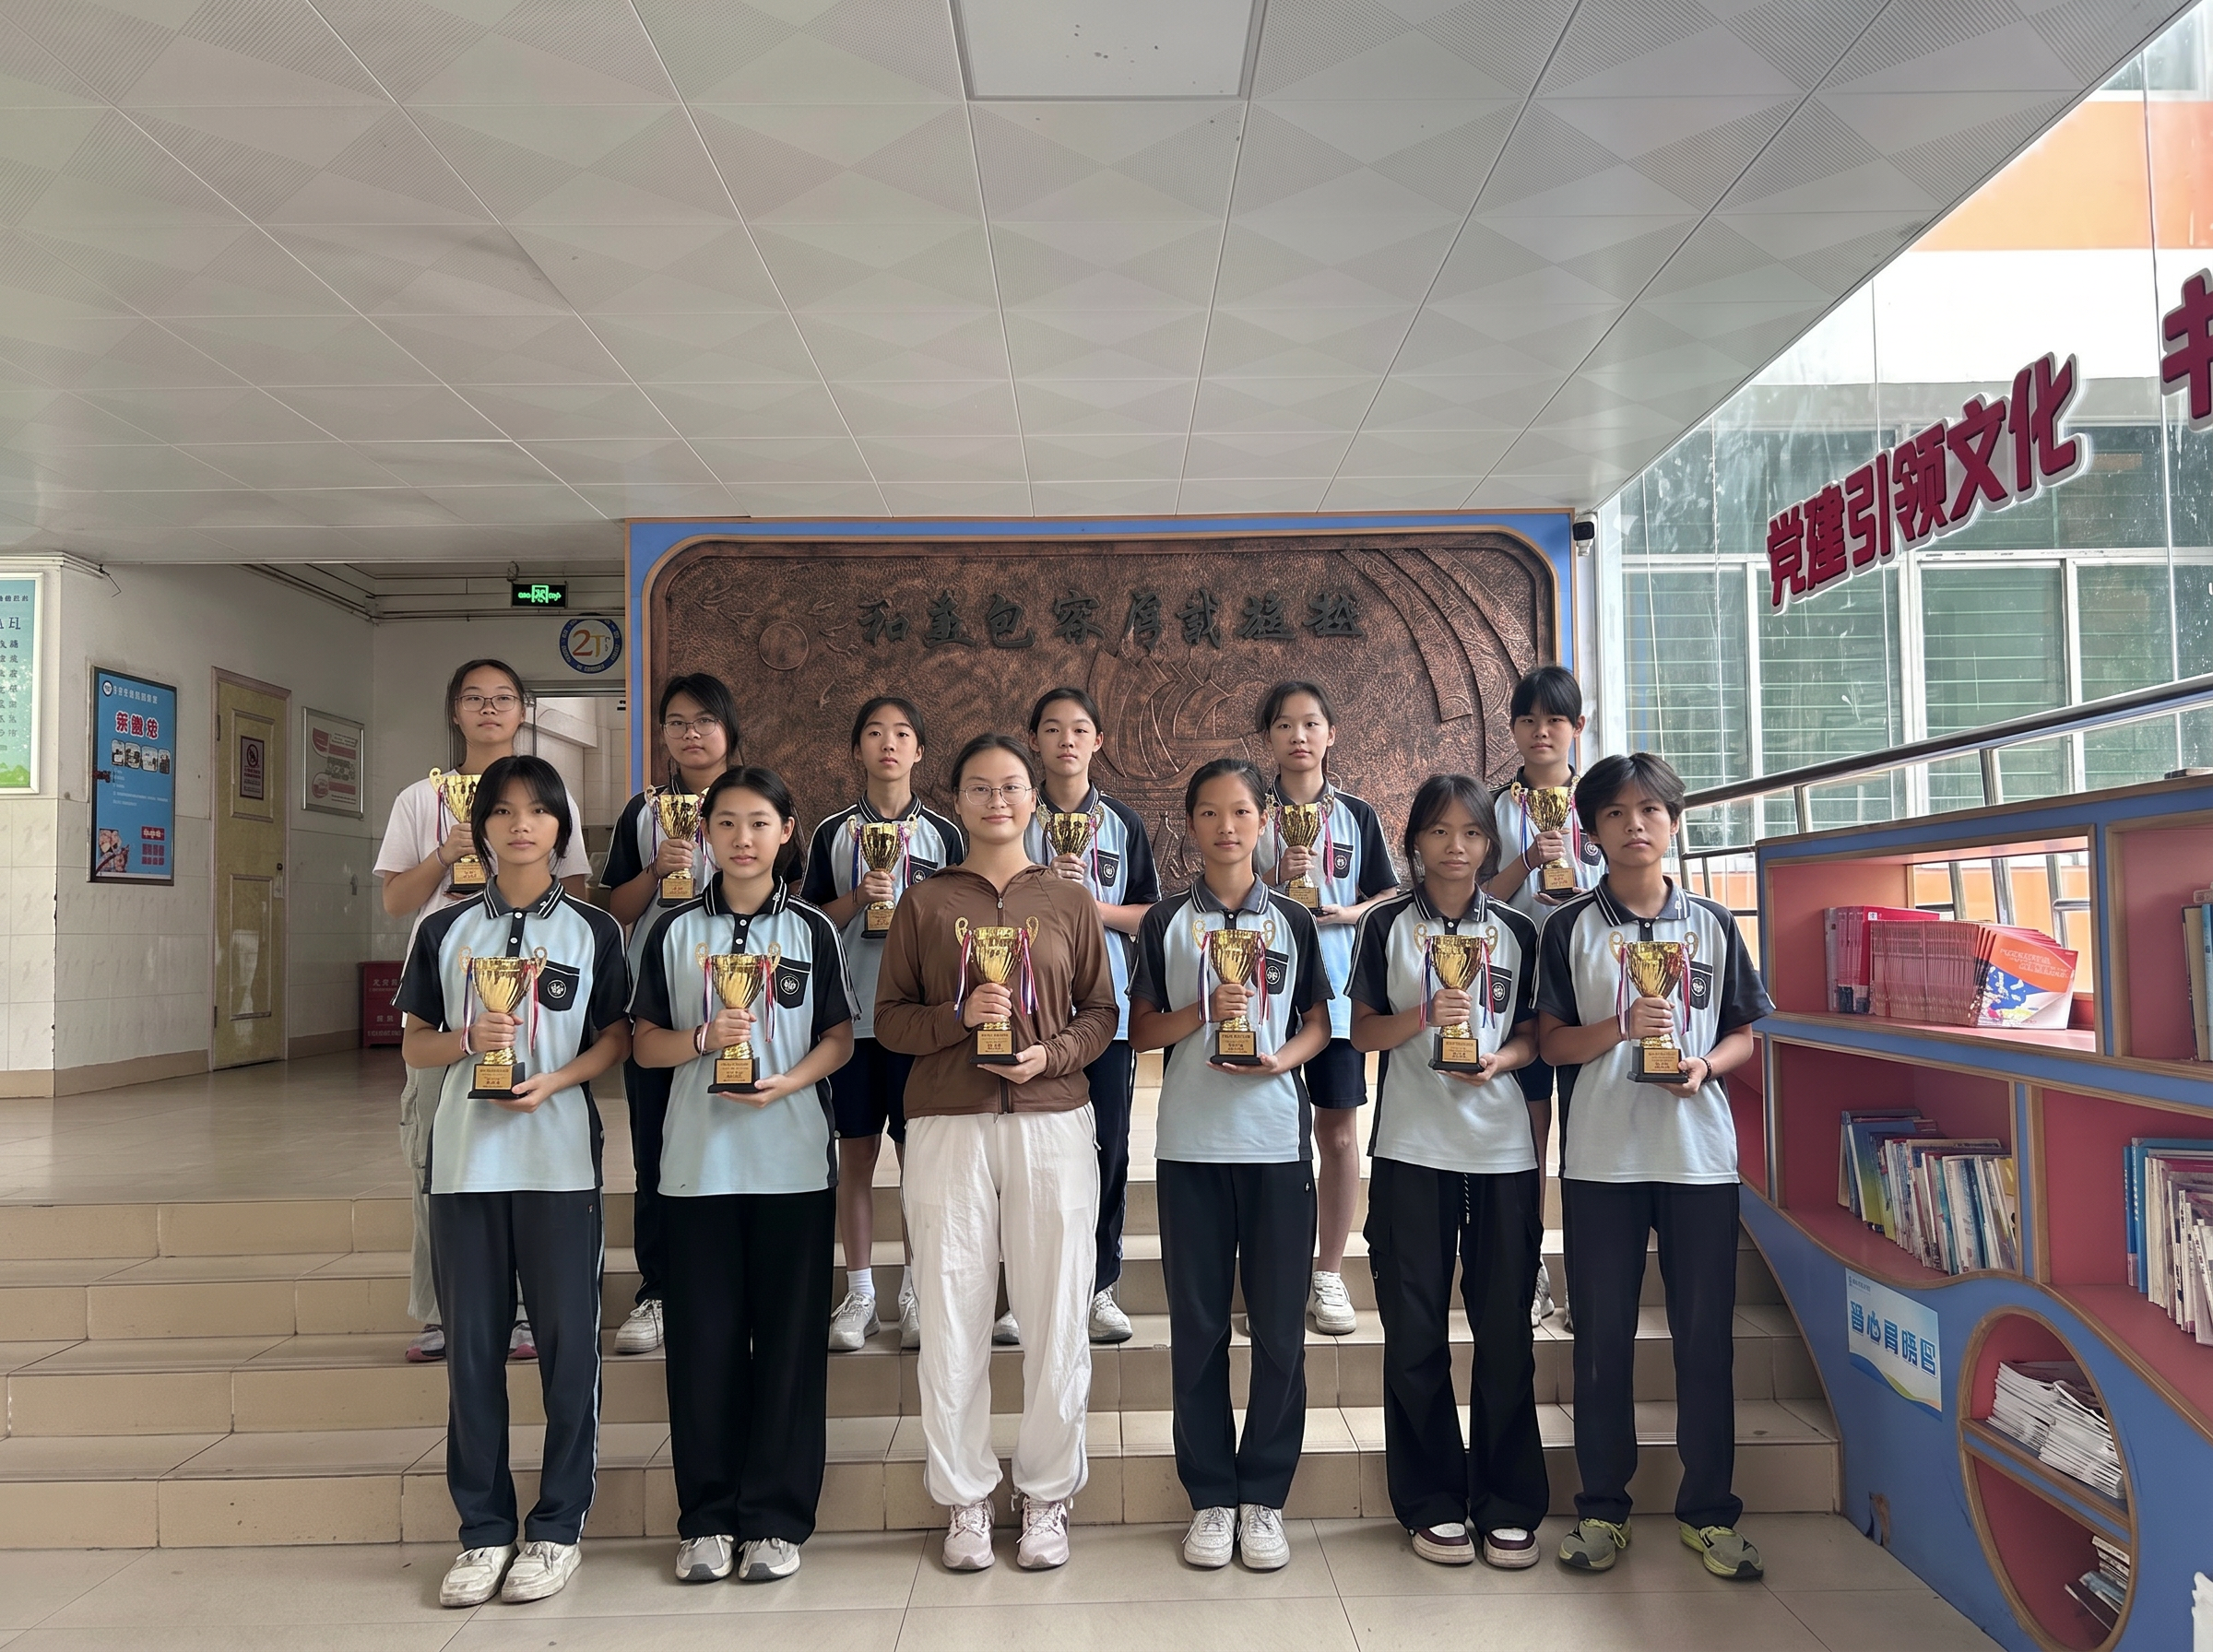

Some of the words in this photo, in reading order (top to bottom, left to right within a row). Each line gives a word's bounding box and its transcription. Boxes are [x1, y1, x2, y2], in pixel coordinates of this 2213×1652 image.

[1766, 352, 2081, 610] 党建引领文化
